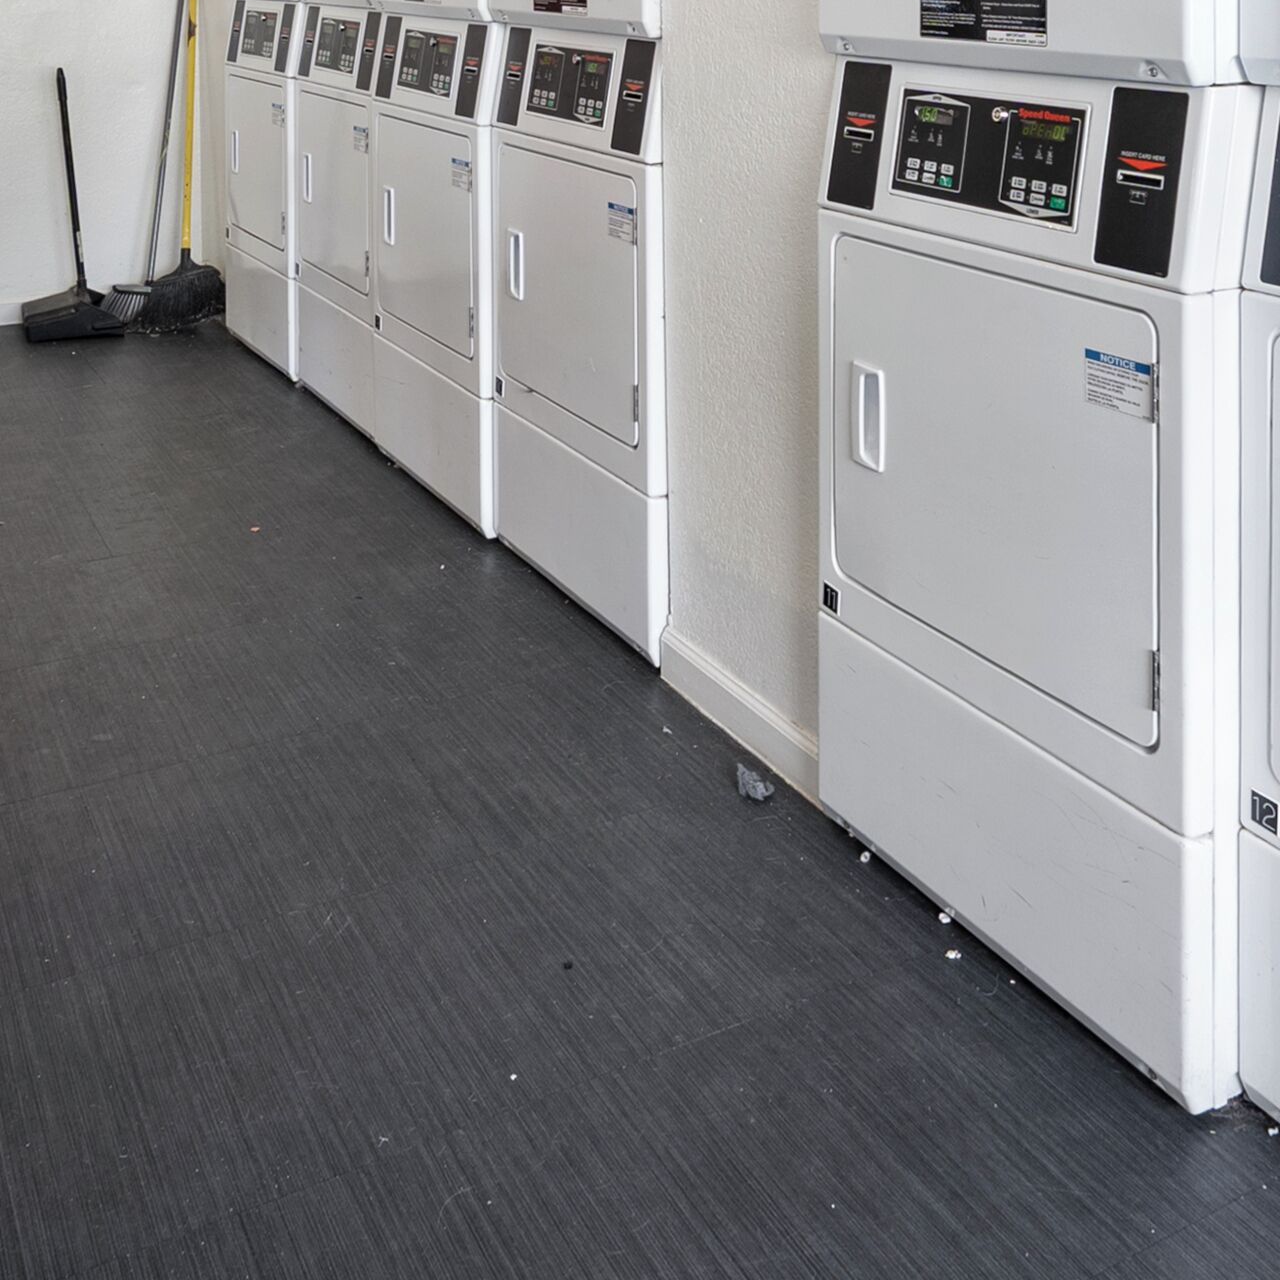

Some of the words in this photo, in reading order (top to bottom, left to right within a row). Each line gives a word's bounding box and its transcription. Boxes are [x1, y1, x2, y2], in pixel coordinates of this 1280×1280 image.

[1019, 108, 1044, 120] Speed
[1044, 110, 1072, 122] Queen
[1138, 152, 1152, 160] CARD
[1100, 353, 1136, 371] NOTICE
[826, 587, 837, 610] 11
[1253, 795, 1277, 832] 12
